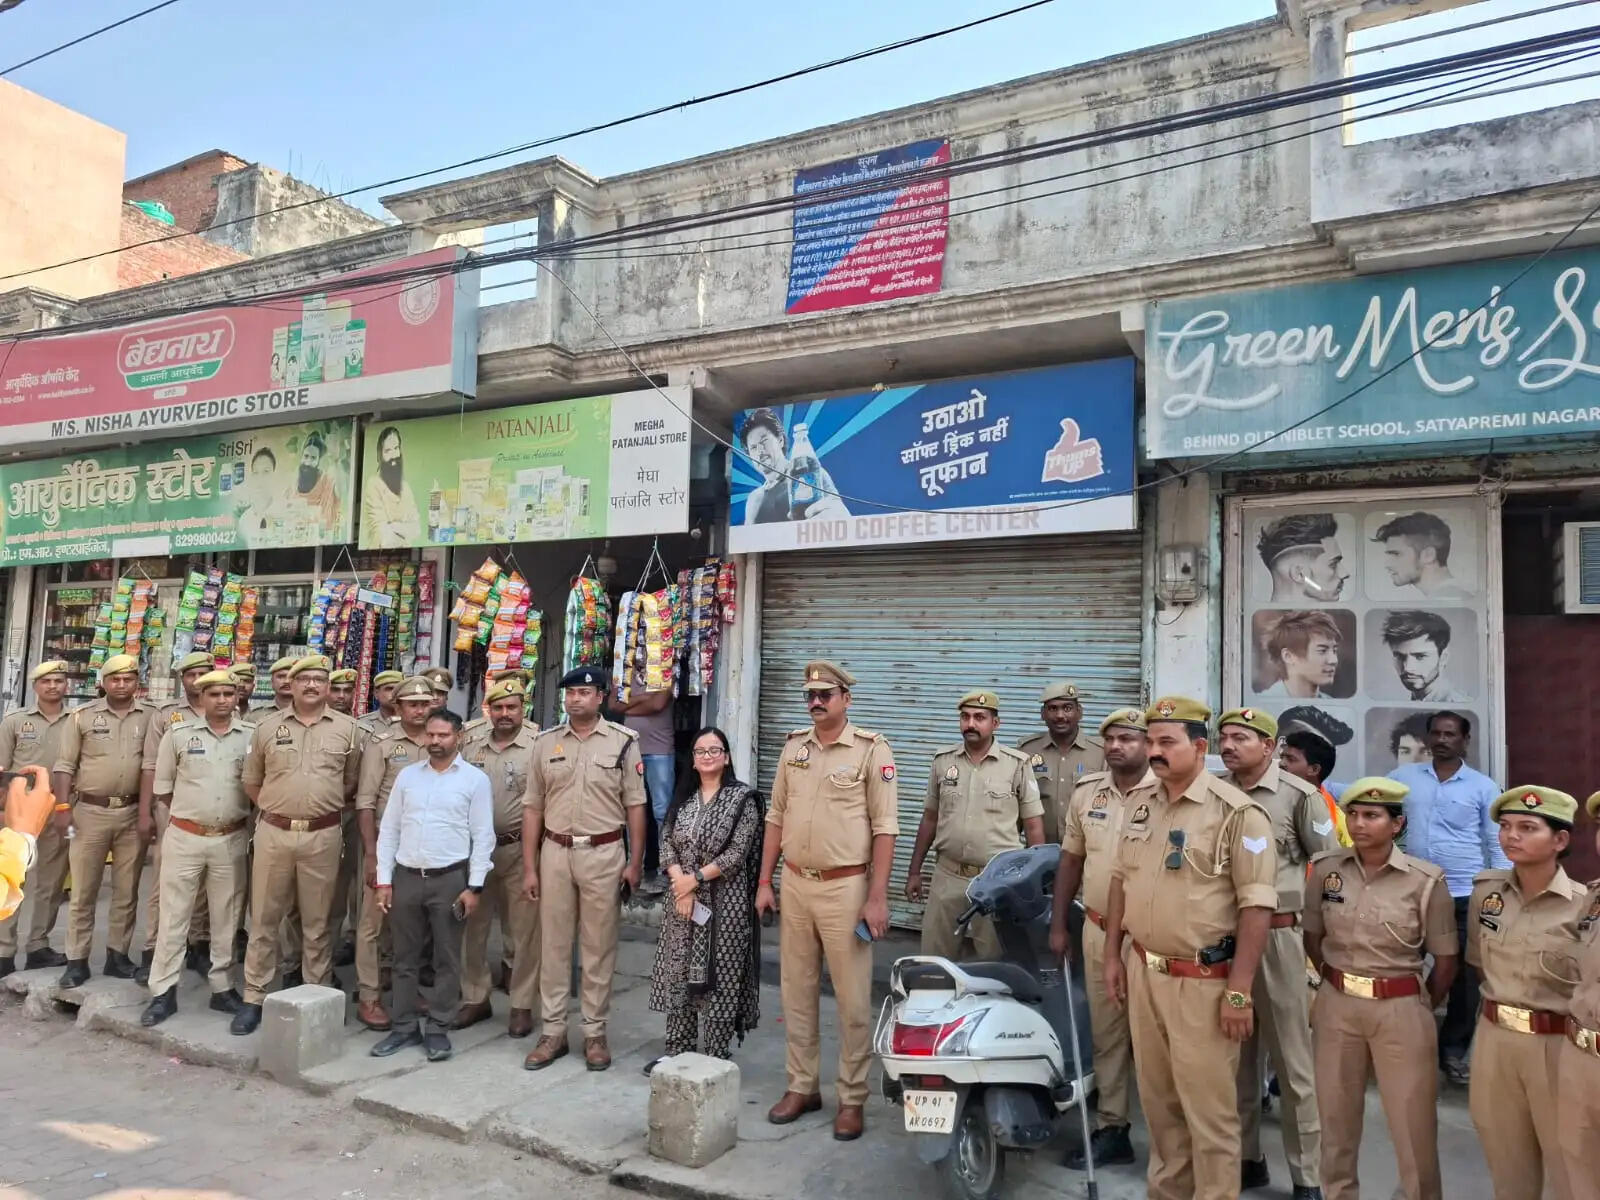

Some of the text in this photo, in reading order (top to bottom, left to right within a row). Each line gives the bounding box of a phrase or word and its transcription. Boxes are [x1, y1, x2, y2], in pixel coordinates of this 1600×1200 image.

[1158, 310, 1340, 419] Green
[1336, 285, 1520, 393] Men's
[141, 370, 168, 383] असली
[51, 387, 309, 437] M/S. NISHA AYURVEDIC STORE
[487, 412, 571, 440] PATANJALI
[634, 419, 664, 432] MEGHA
[921, 389, 987, 433] उठाओ
[1184, 406, 1600, 449] BEHIND OLD NIBLET SCHOOL, SATYAPREMI NAGAR
[612, 431, 687, 449] PATANJALI STORE
[901, 416, 1009, 464] सॉफ्ट ड्रिंक नहीं
[8, 448, 216, 528] आयुर्वेदिक स्टोर
[638, 466, 659, 483] मेघा
[920, 451, 989, 496] तूफान
[611, 486, 686, 508] पतंजलि स्टोर
[797, 505, 1040, 544] HIND COFFEE CENTER
[915, 1096, 927, 1105] UP
